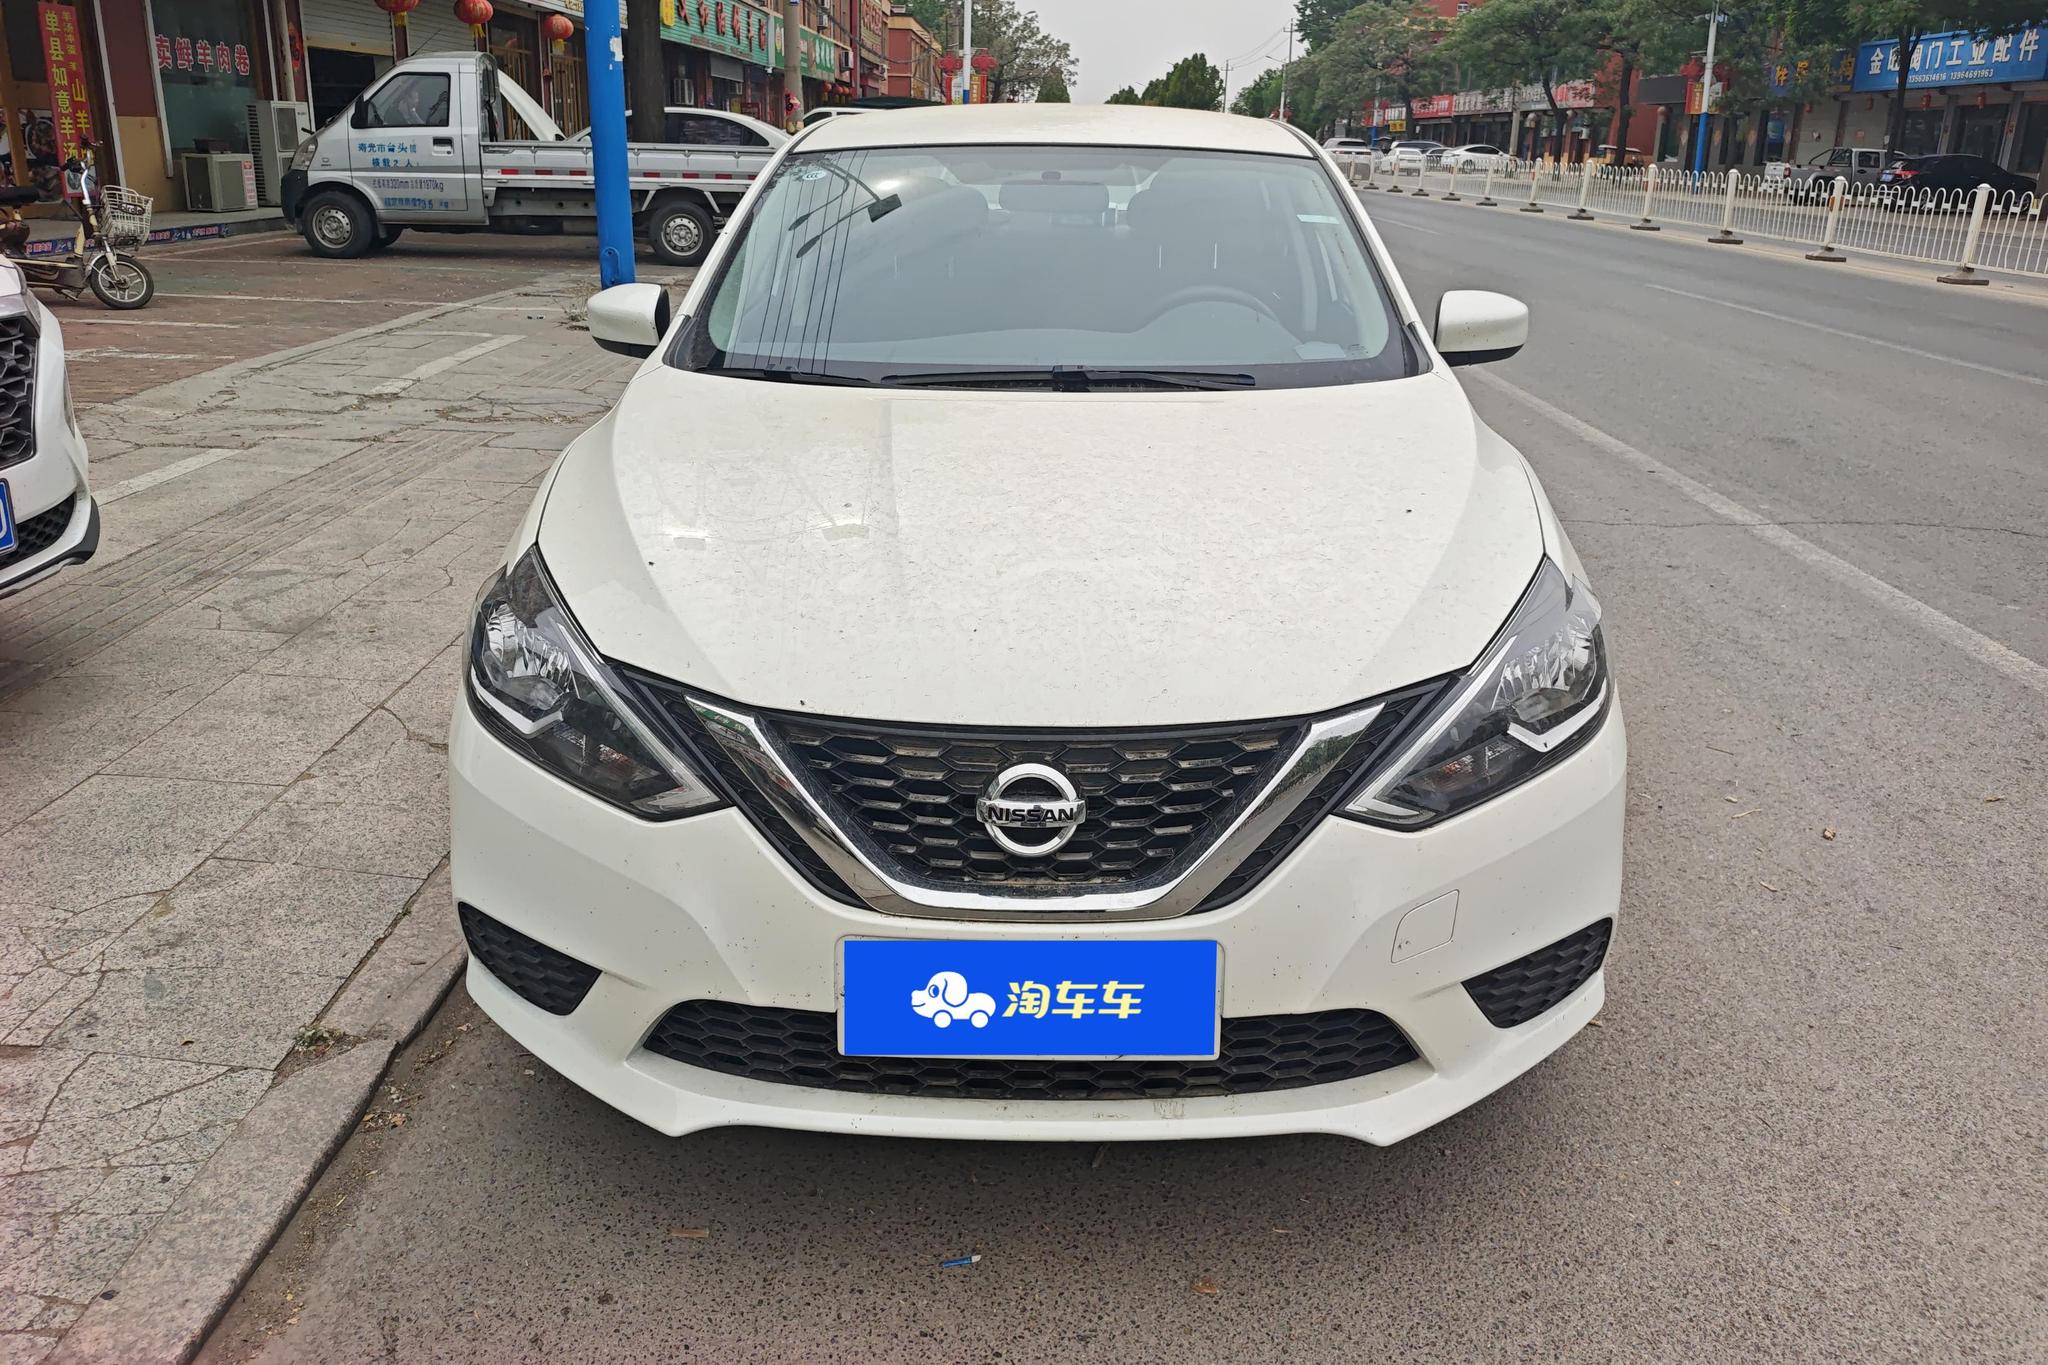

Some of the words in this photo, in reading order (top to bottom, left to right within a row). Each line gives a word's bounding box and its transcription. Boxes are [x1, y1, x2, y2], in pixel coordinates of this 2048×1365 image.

[155, 33, 250, 76] 卖鲜羊肉卷
[45, 10, 79, 161] 单县如意羊汤
[987, 806, 1075, 823] NISSAN
